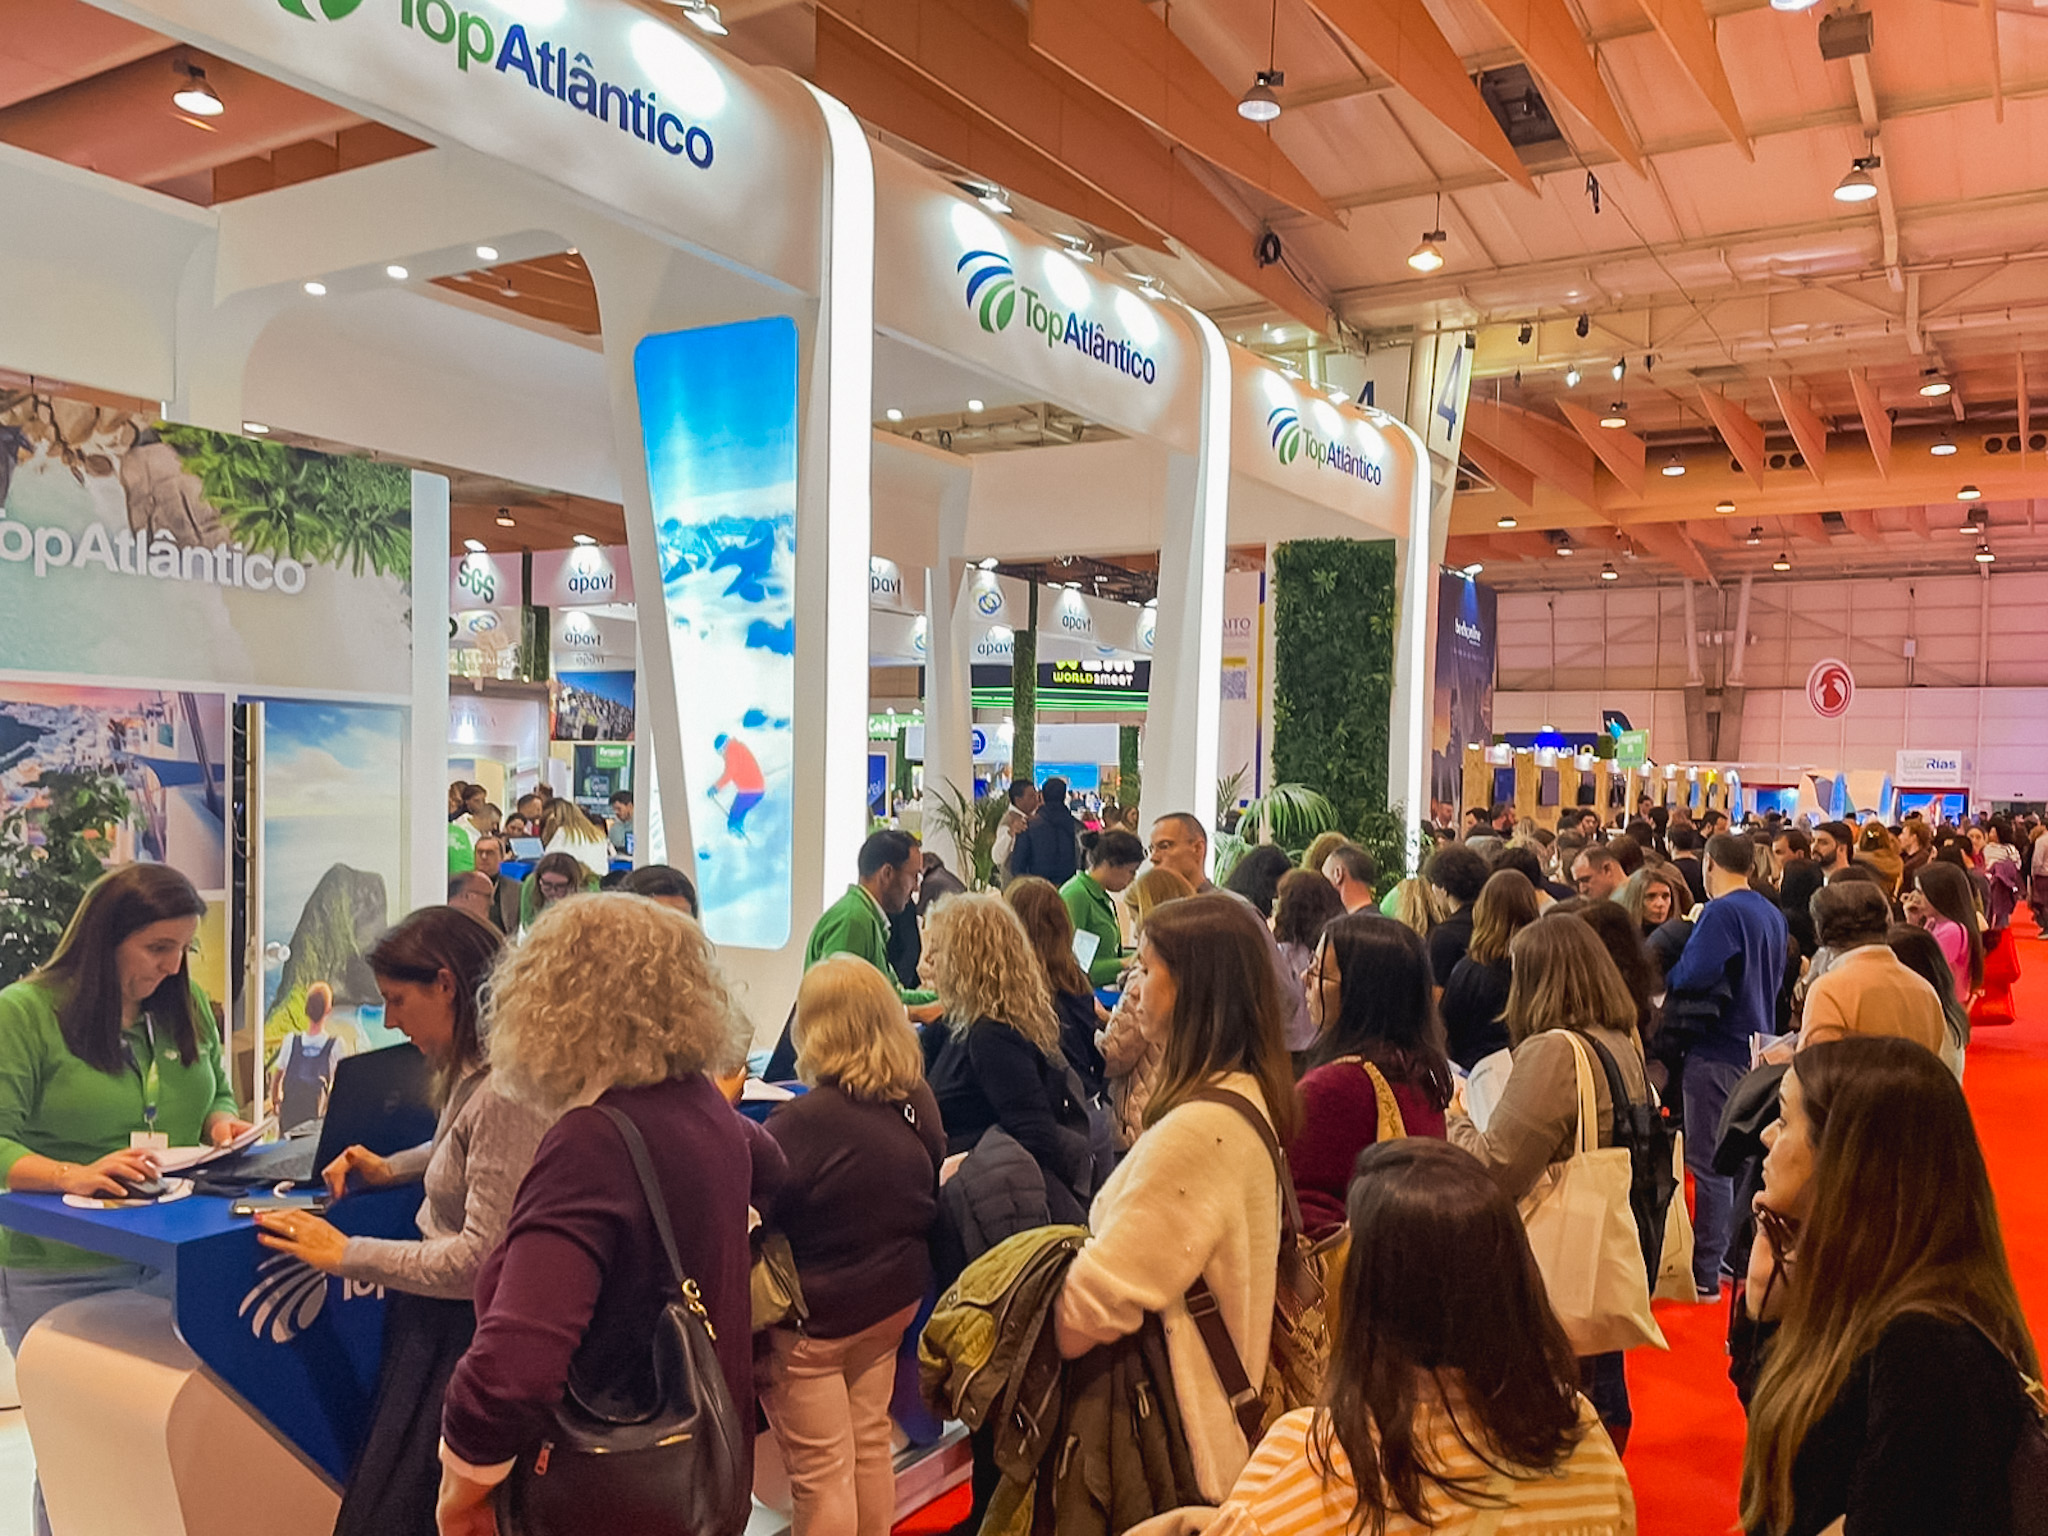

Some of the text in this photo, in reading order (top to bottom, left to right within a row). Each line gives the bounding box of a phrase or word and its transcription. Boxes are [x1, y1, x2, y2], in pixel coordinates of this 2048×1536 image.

[1020, 286, 1156, 385] TopAtlântico
[1437, 344, 1463, 441] 4
[1303, 428, 1382, 486] TopAtlântico
[0, 507, 307, 595] opAtlântico
[459, 560, 495, 603] SGS
[568, 572, 615, 595] apavt
[871, 575, 901, 595] pavt
[565, 632, 602, 647] apavt
[1062, 615, 1092, 632] apavt
